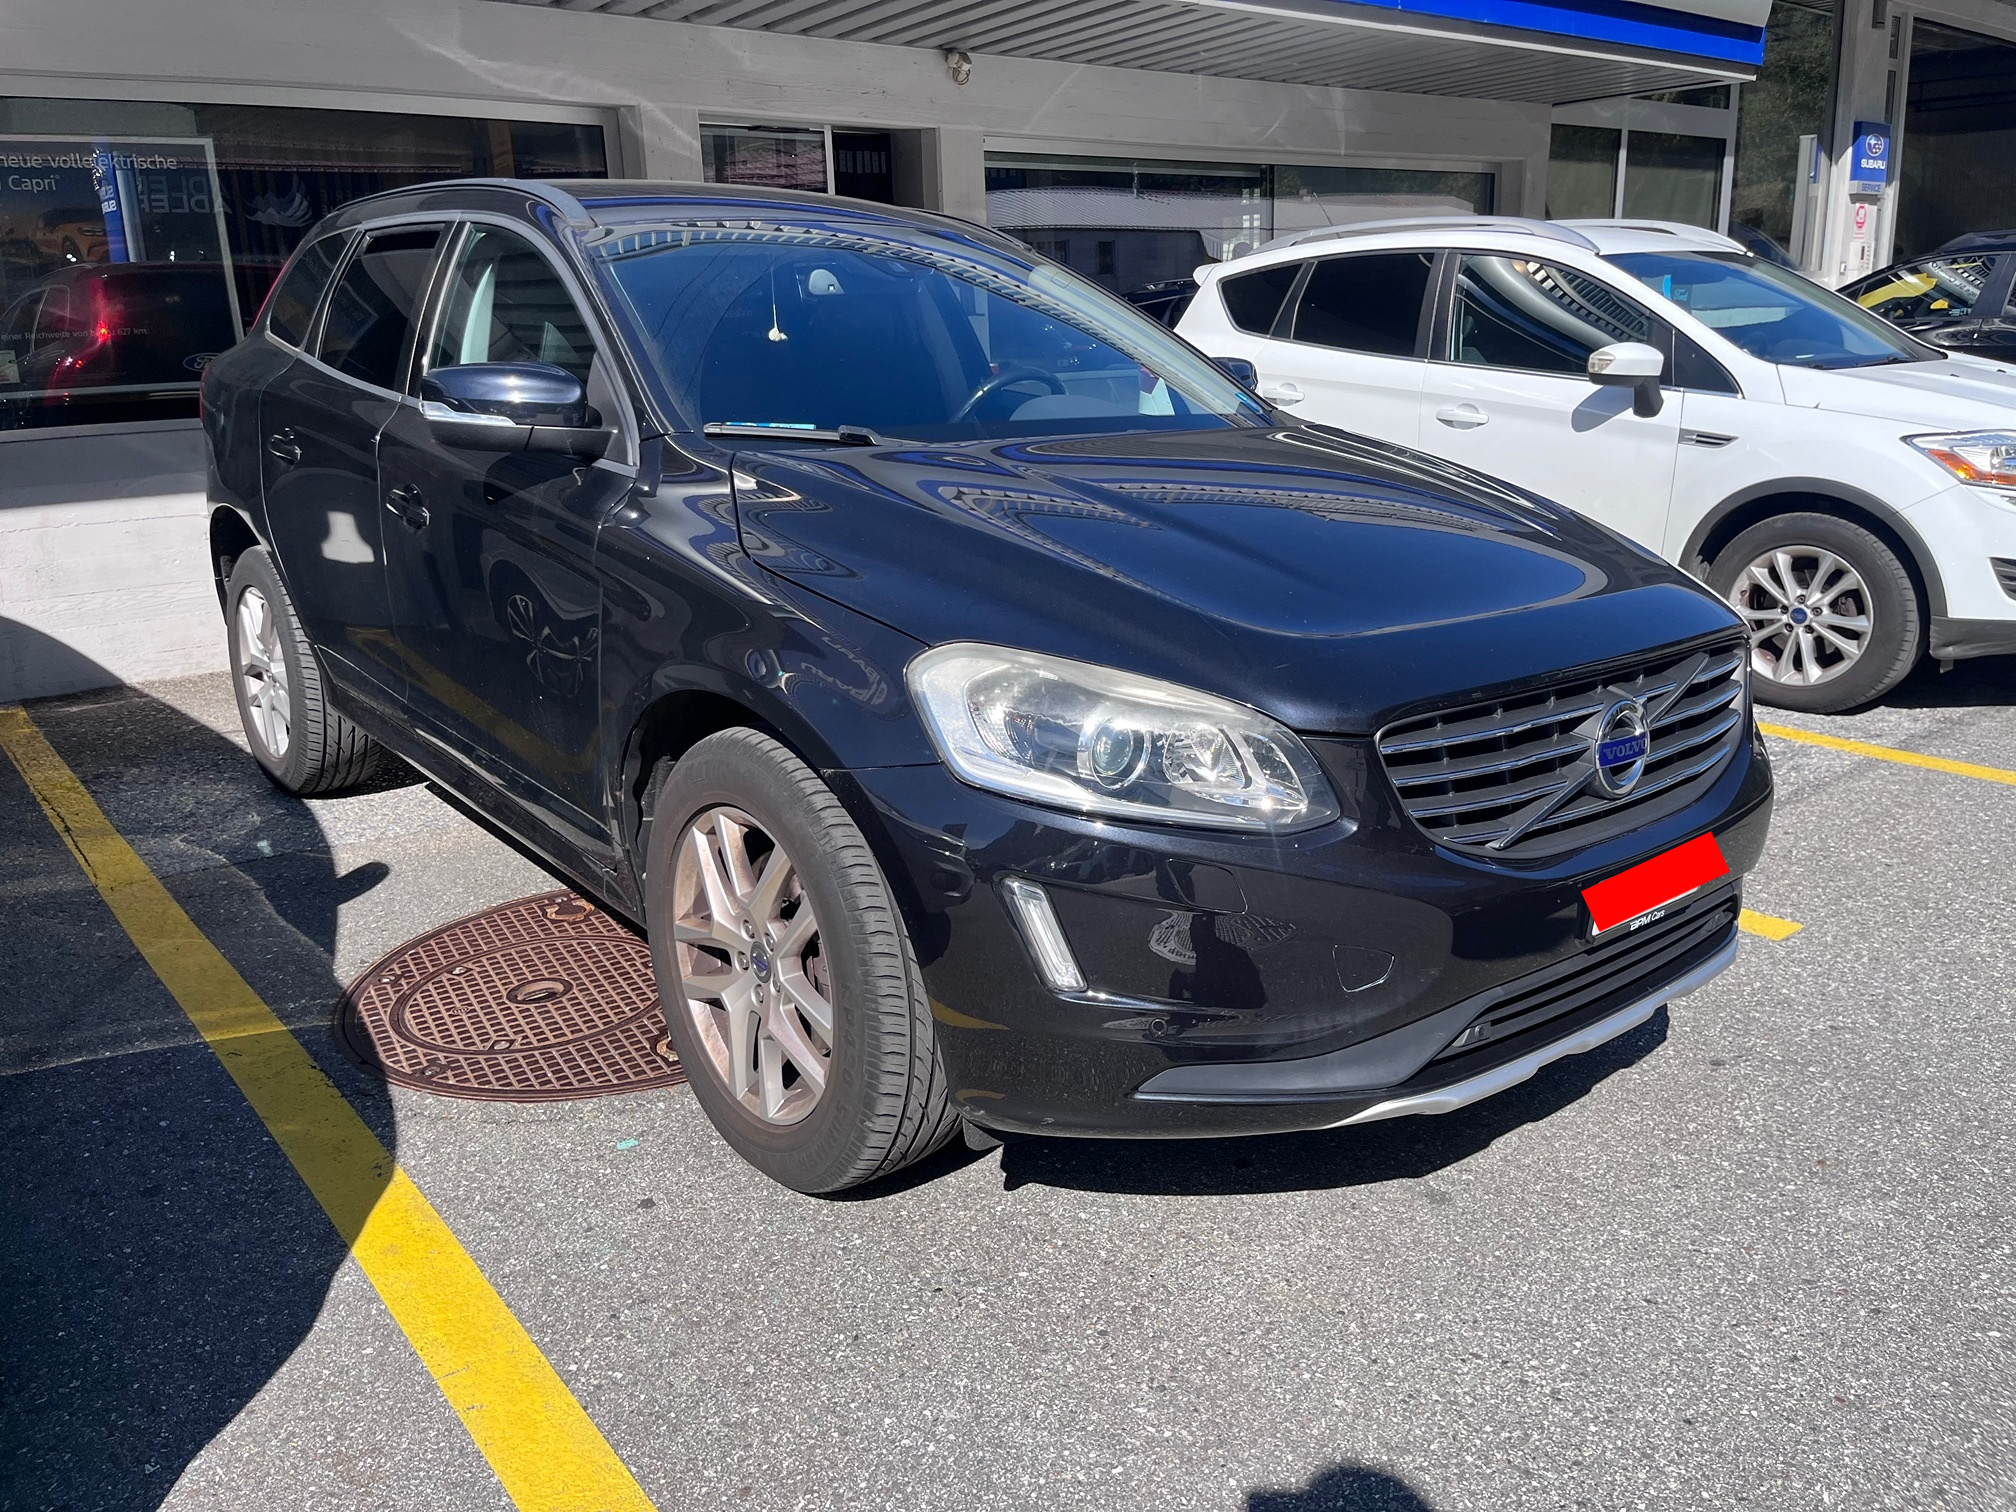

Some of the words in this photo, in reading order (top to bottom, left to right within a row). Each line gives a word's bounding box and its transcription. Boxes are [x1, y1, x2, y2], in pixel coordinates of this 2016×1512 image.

[1860, 158, 1886, 170] SUBARU
[1861, 183, 1881, 193] SERVICE
[117, 327, 131, 336] 627
[1603, 738, 1648, 760] VOLVO
[1629, 913, 1652, 931] BPM
[1651, 909, 1665, 921] Cars
